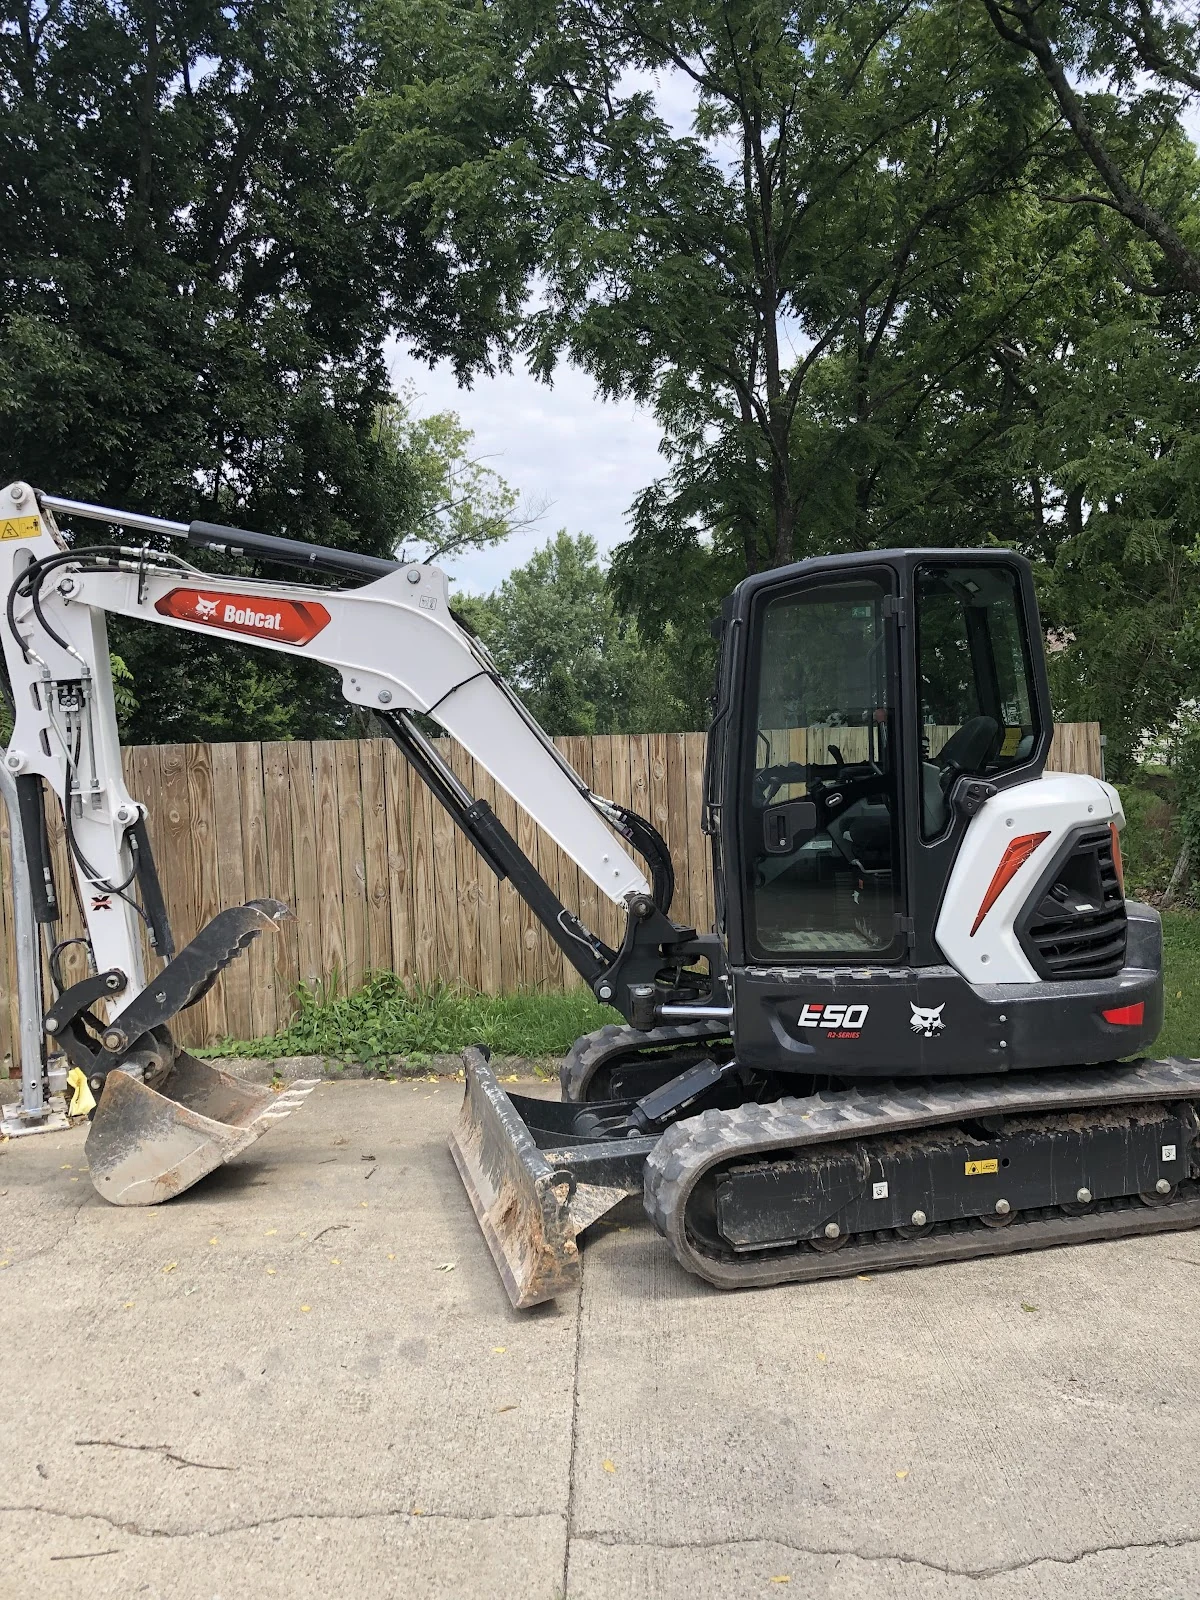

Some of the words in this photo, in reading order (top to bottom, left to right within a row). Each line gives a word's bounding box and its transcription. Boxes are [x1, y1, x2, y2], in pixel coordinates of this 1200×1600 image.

[224, 604, 282, 631] Bobcat
[797, 1004, 870, 1029] E50
[827, 1031, 861, 1039] R2-SERIES
